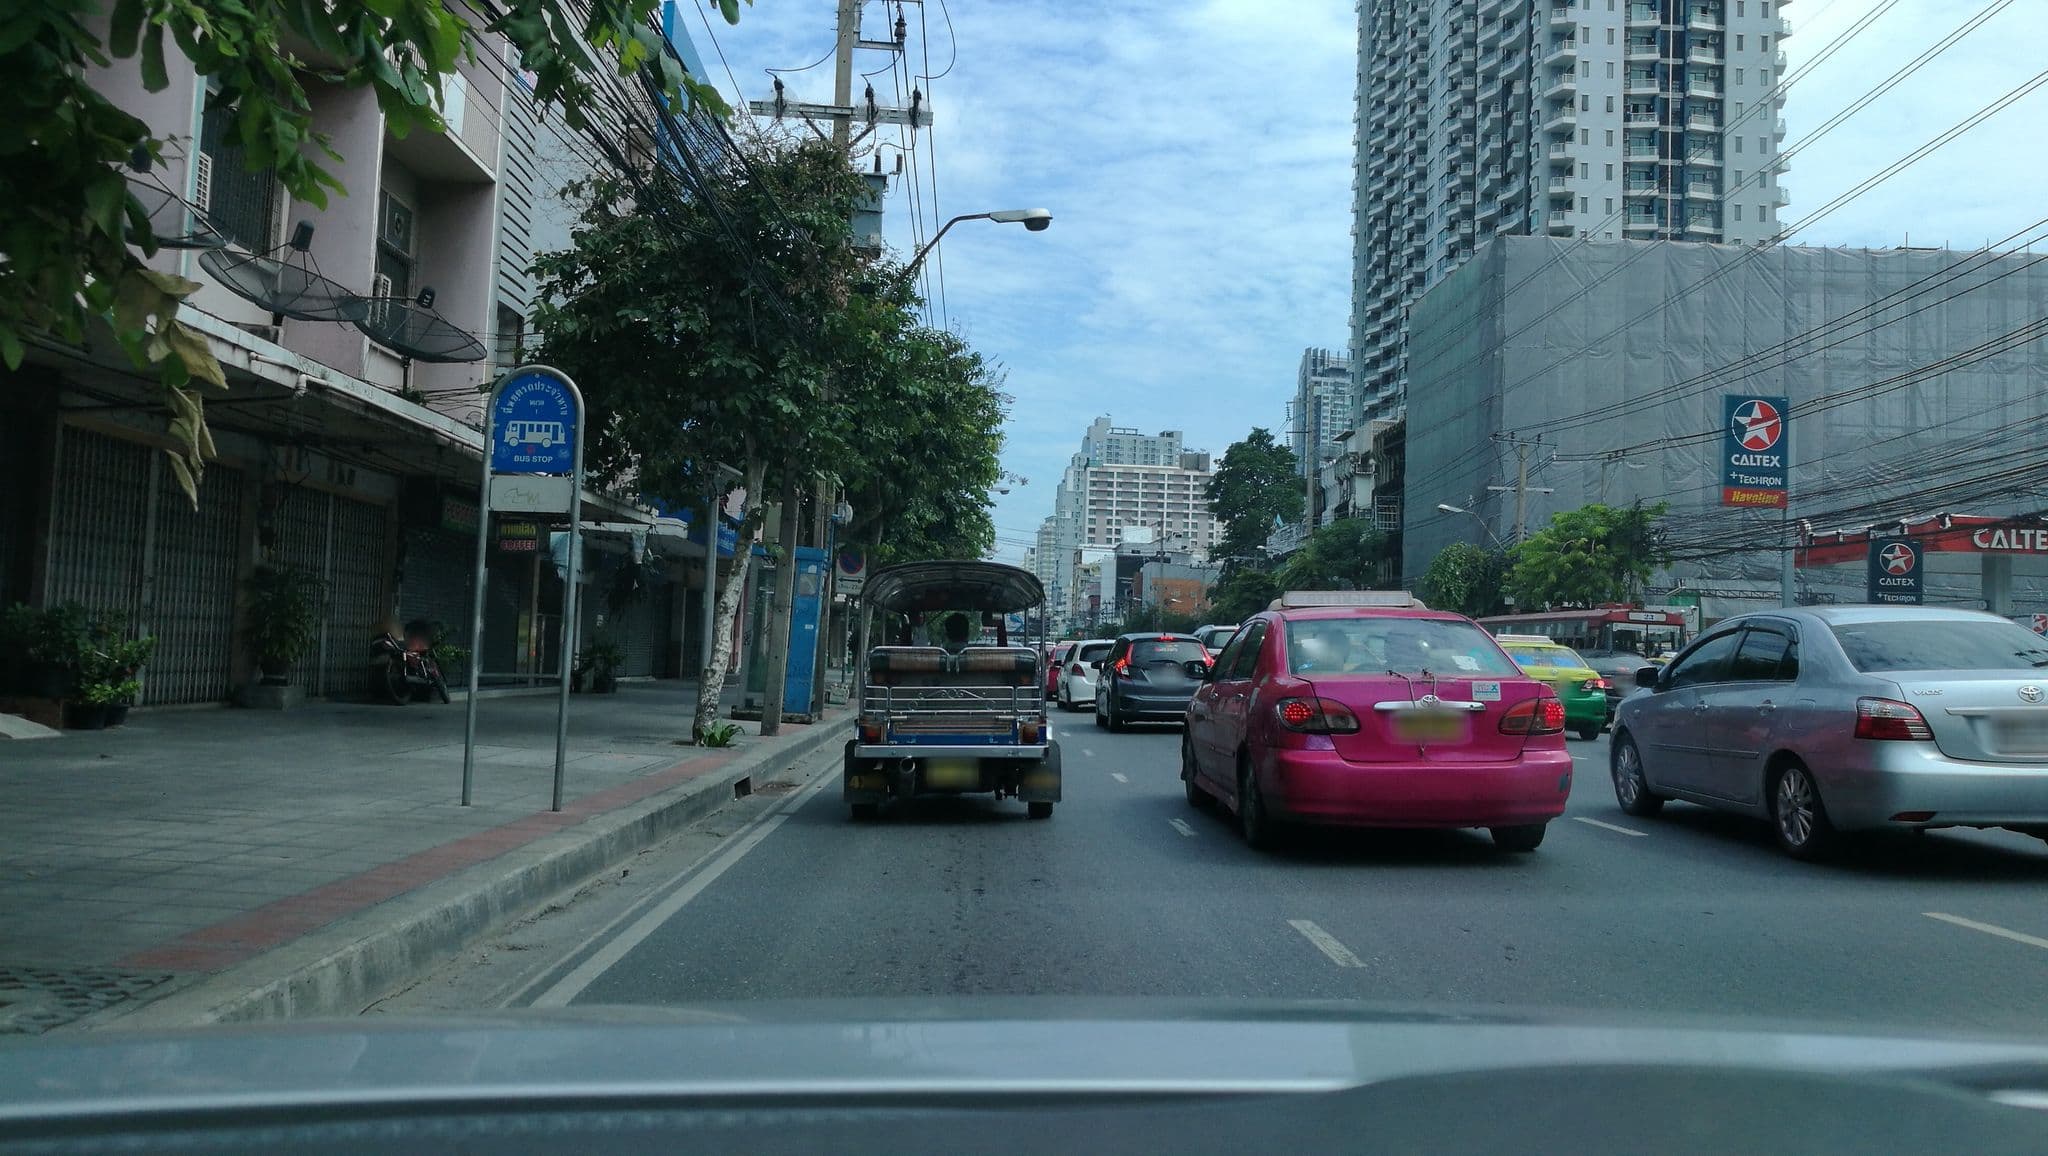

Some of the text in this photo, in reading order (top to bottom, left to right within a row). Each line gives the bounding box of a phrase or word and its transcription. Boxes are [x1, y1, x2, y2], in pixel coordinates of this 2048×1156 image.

[514, 455, 553, 464] BUS STOP
[1731, 454, 1781, 468] CALTEX
[1732, 490, 1779, 504] Havoline
[1879, 577, 1915, 586] CALTEX
